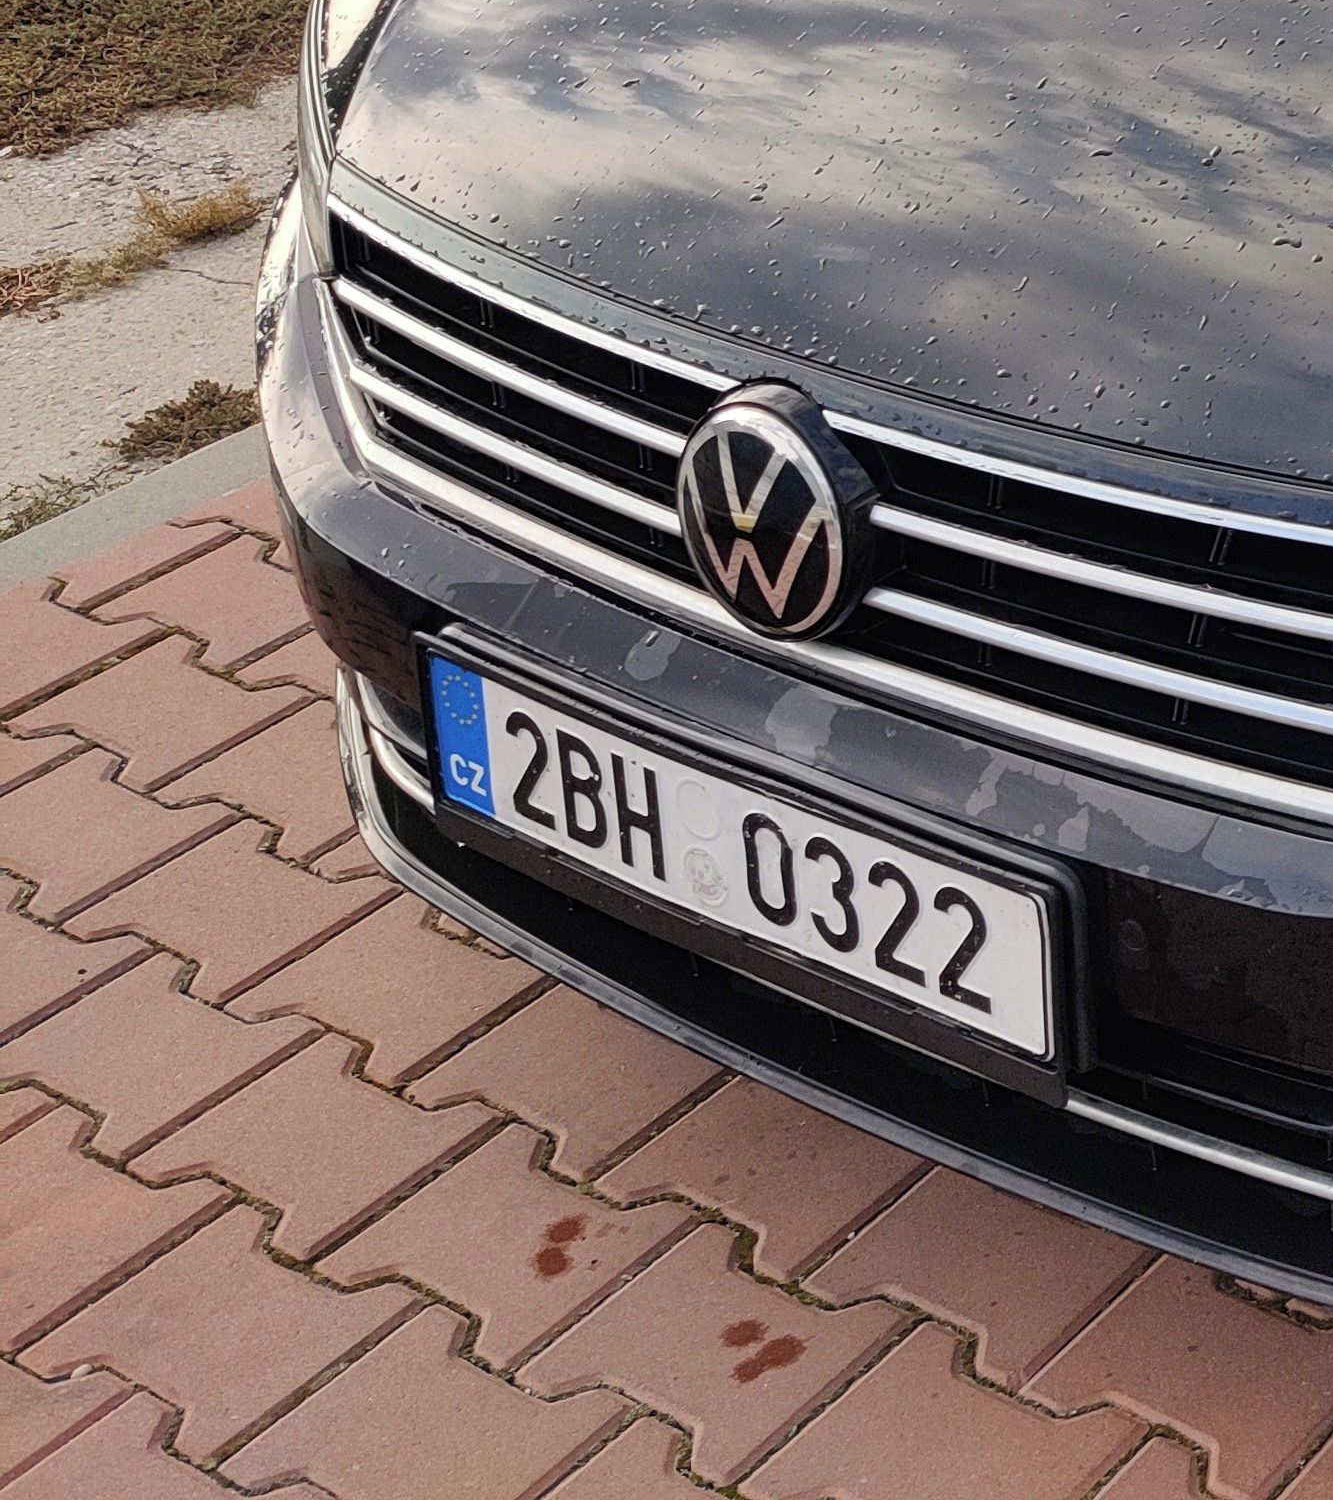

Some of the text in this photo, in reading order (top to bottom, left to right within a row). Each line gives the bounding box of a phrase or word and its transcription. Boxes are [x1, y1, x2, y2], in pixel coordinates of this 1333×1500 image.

[448, 752, 488, 797] CZ
[504, 708, 993, 1014] 2BH 0322
